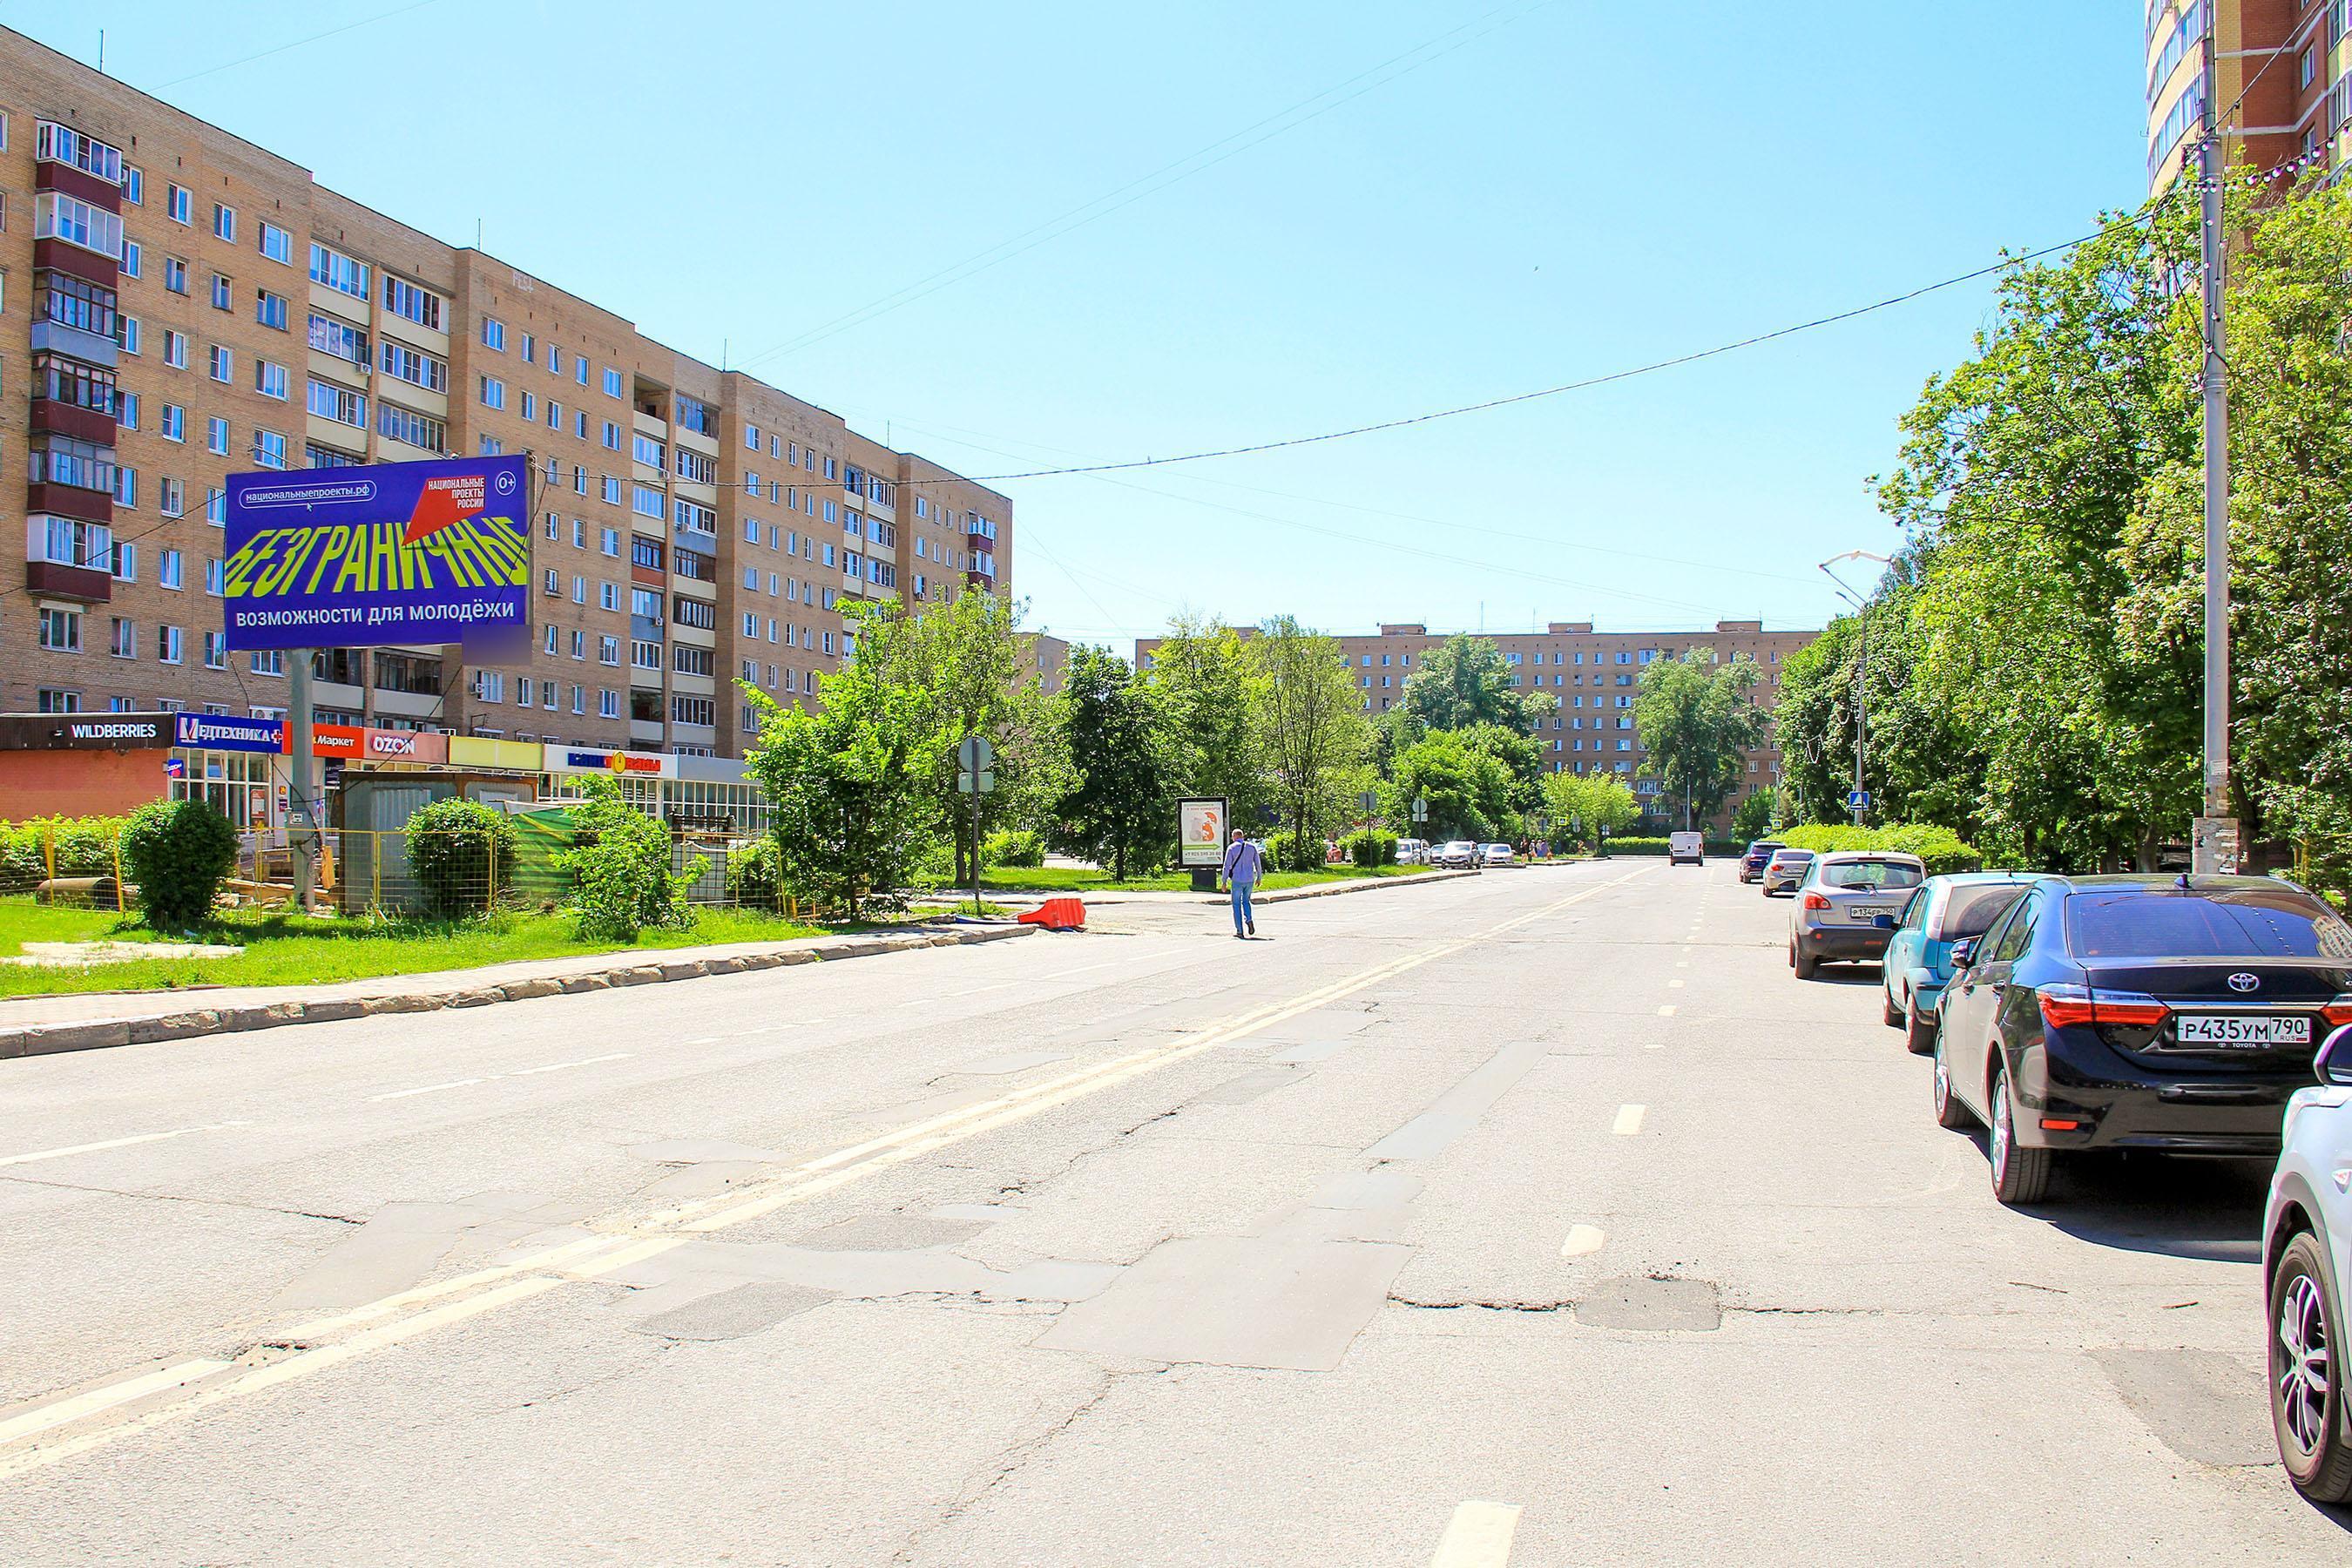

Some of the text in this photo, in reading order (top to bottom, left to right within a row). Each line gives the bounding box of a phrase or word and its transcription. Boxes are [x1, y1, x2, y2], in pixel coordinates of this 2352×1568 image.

[428, 477, 484, 490] НАЦИОНАЛЬНЫЕ
[498, 476, 515, 489] 0+
[246, 483, 370, 503] национальныепроекты.рф
[451, 488, 484, 498] ПРОЕКТЫ
[457, 498, 484, 509] РОССИИ
[71, 724, 157, 739] WILDBERRIES
[317, 735, 355, 747] Маркет
[372, 735, 415, 754] OZON
[2272, 1018, 2305, 1034] 790
